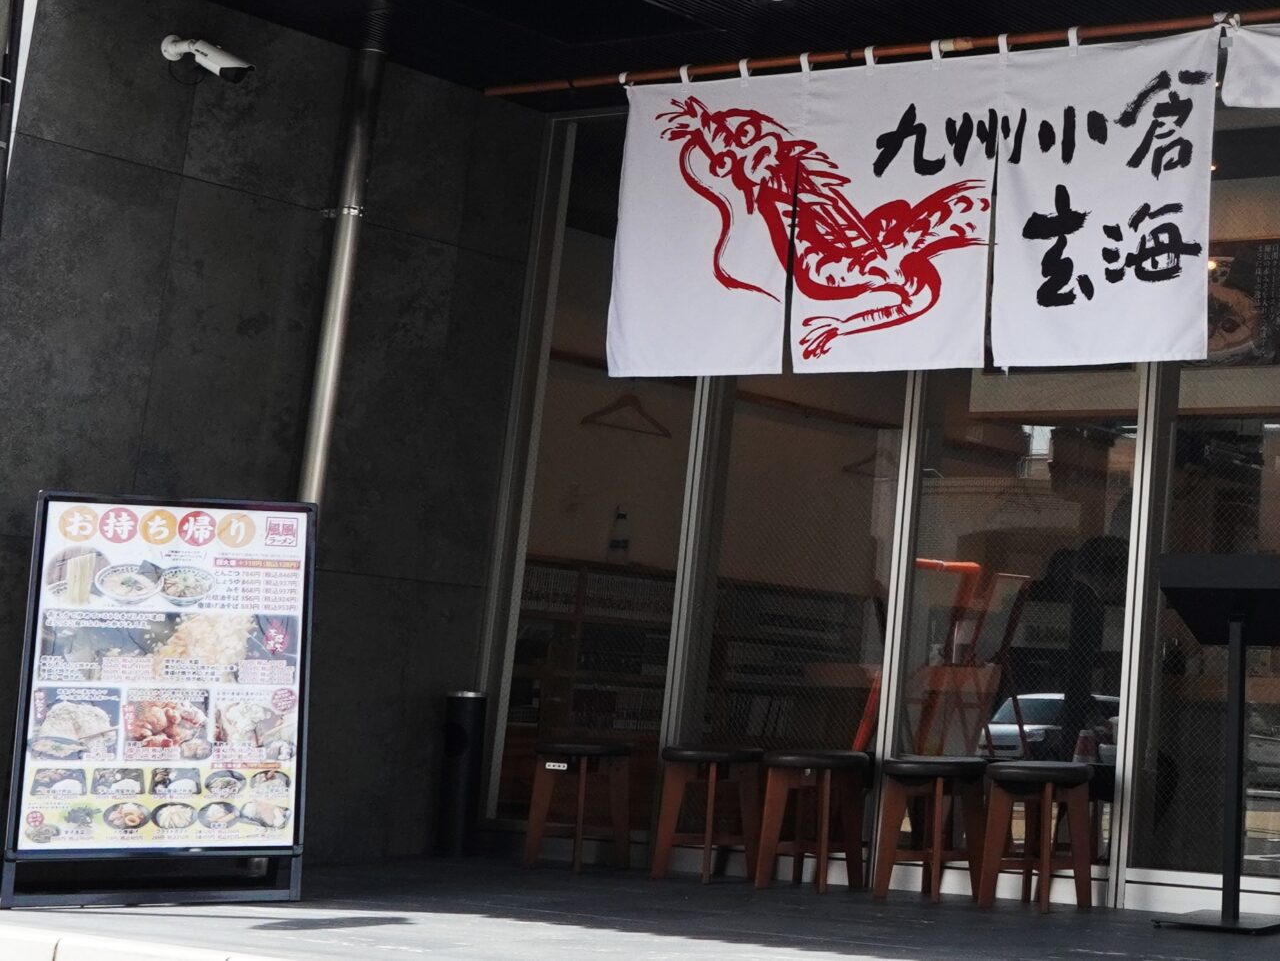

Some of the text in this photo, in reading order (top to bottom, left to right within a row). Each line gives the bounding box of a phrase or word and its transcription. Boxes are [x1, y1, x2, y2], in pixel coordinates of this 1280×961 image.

[873, 70, 1213, 179] 九州小倉
[1022, 184, 1201, 308] 玄海
[65, 512, 245, 544] お持ち帰り
[268, 537, 295, 545] ラーメン
